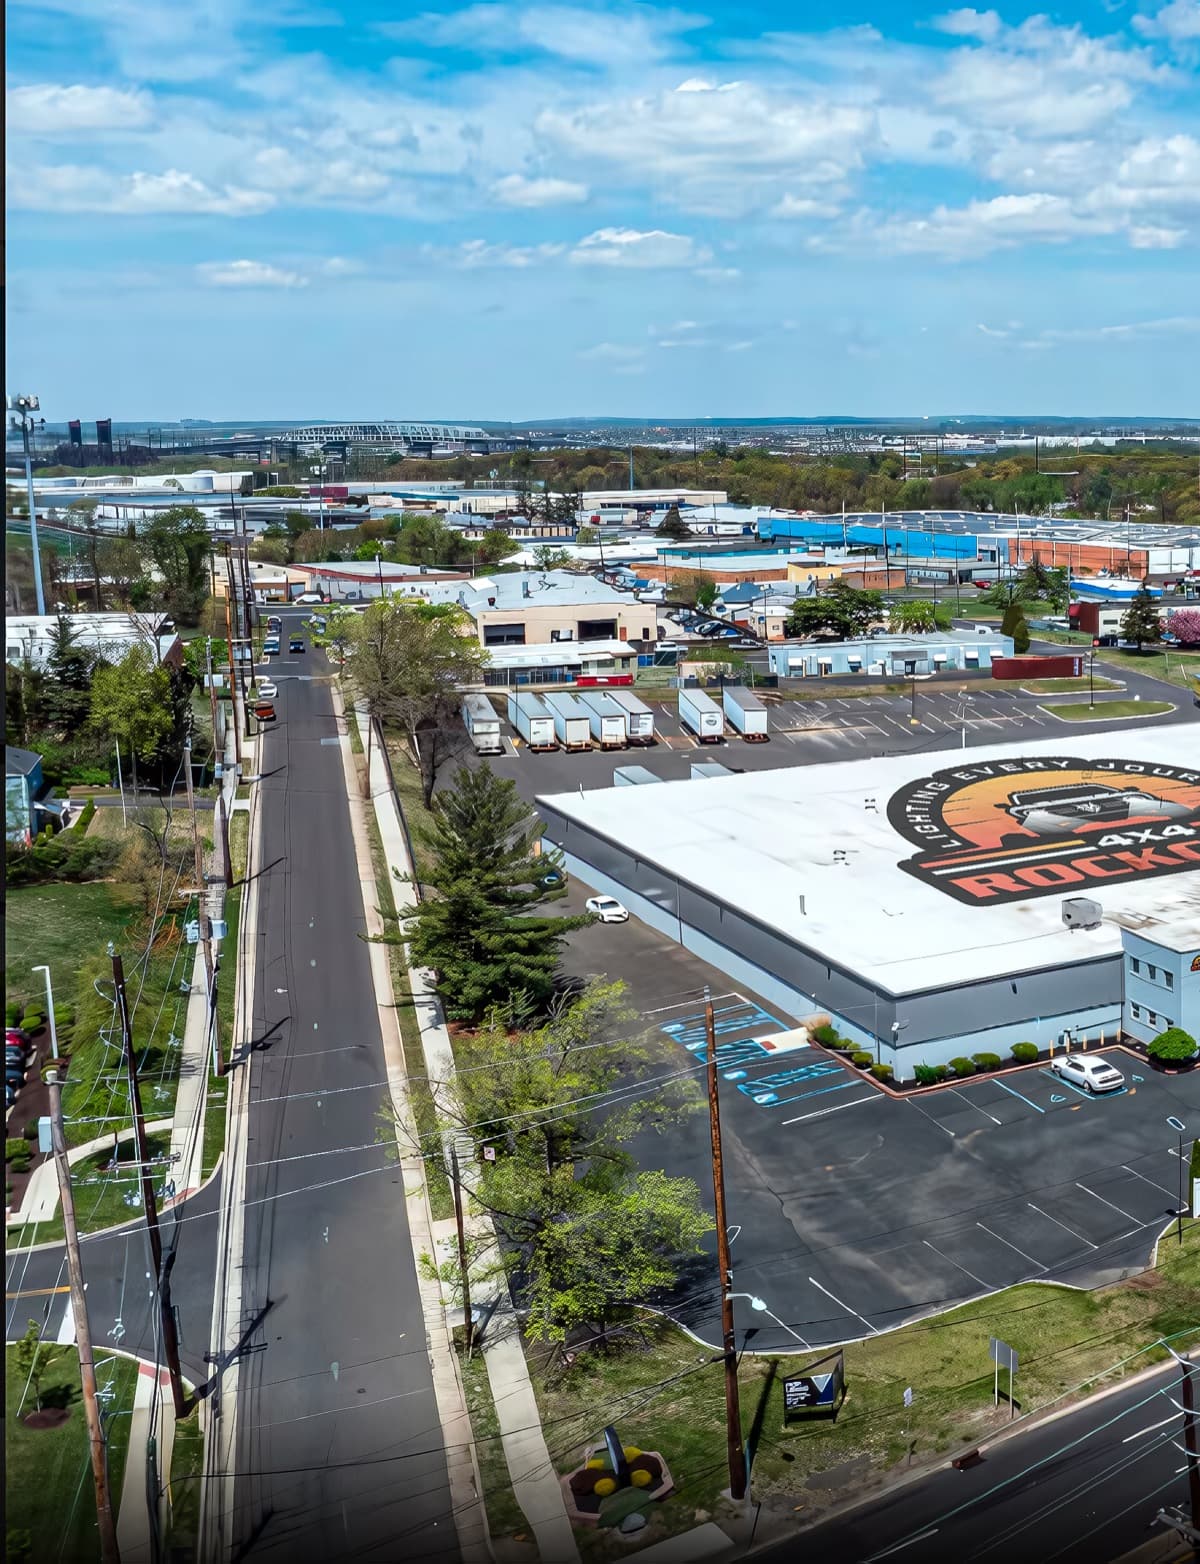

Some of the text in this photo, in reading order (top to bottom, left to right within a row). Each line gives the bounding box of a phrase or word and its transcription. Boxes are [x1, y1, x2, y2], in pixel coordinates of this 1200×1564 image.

[906, 781, 963, 849] LIGHTING
[952, 760, 1070, 781] EVERY
[1098, 825, 1197, 847] 4X4
